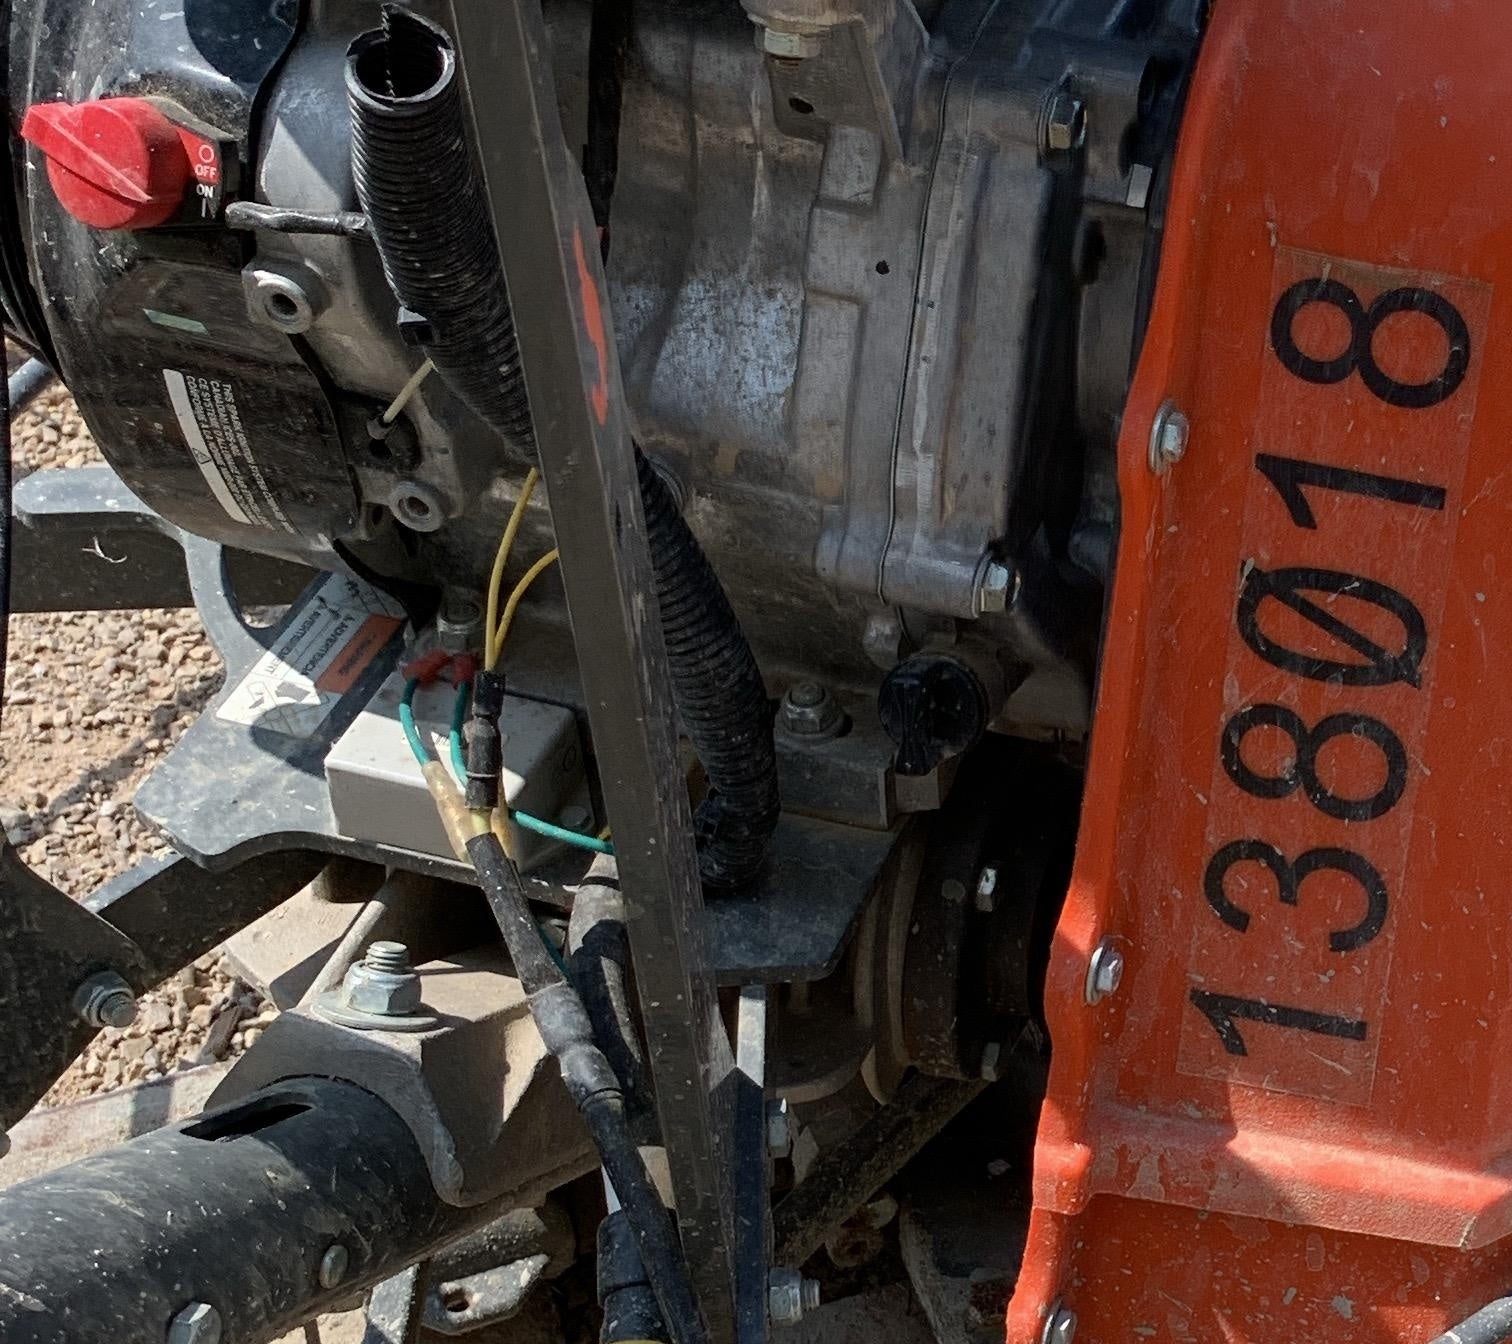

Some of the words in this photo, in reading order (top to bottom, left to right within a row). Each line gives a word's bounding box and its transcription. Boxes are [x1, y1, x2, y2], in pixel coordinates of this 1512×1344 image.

[195, 163, 217, 178] OFF
[196, 183, 214, 198] ON
[1189, 277, 1471, 1057] 138018
